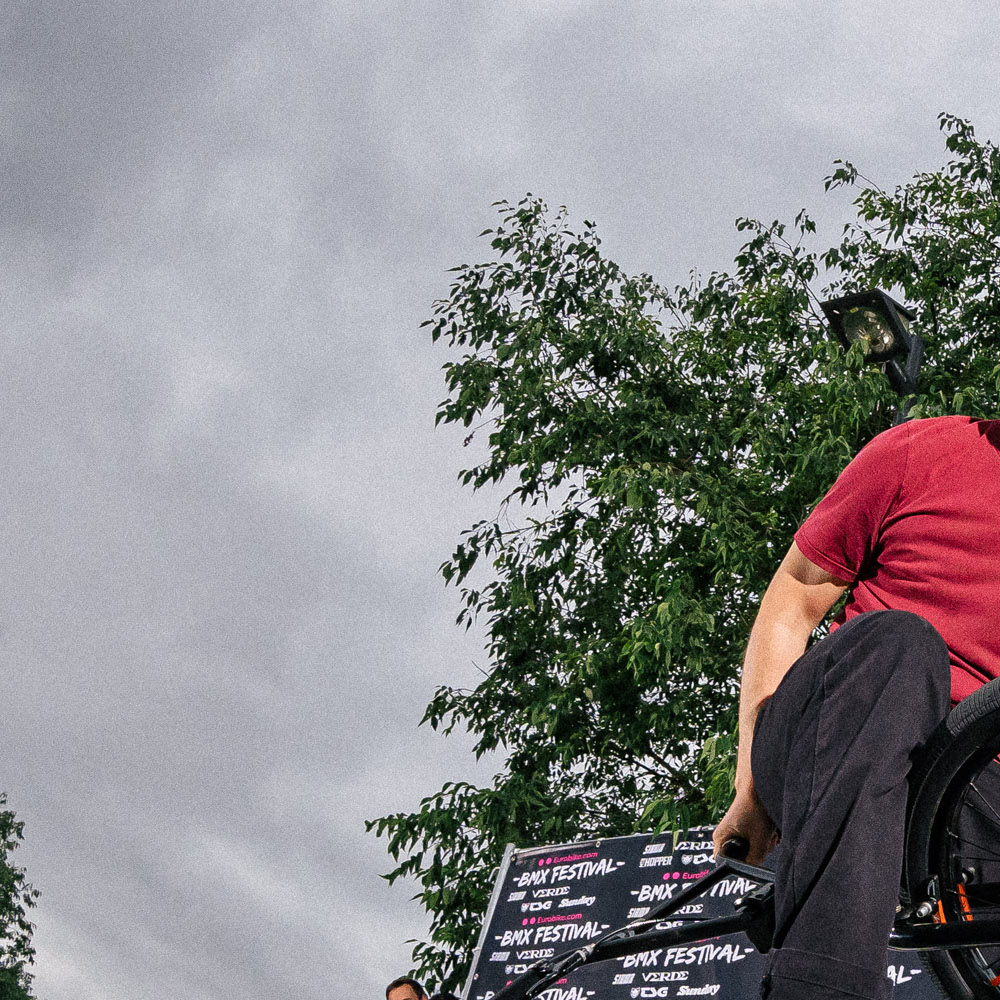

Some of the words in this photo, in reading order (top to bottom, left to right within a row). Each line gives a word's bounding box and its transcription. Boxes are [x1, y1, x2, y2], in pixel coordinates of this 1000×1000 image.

[558, 895, 596, 908] Sunday
[537, 913, 583, 924] Eurobike.com
[676, 983, 721, 996] Sunday
